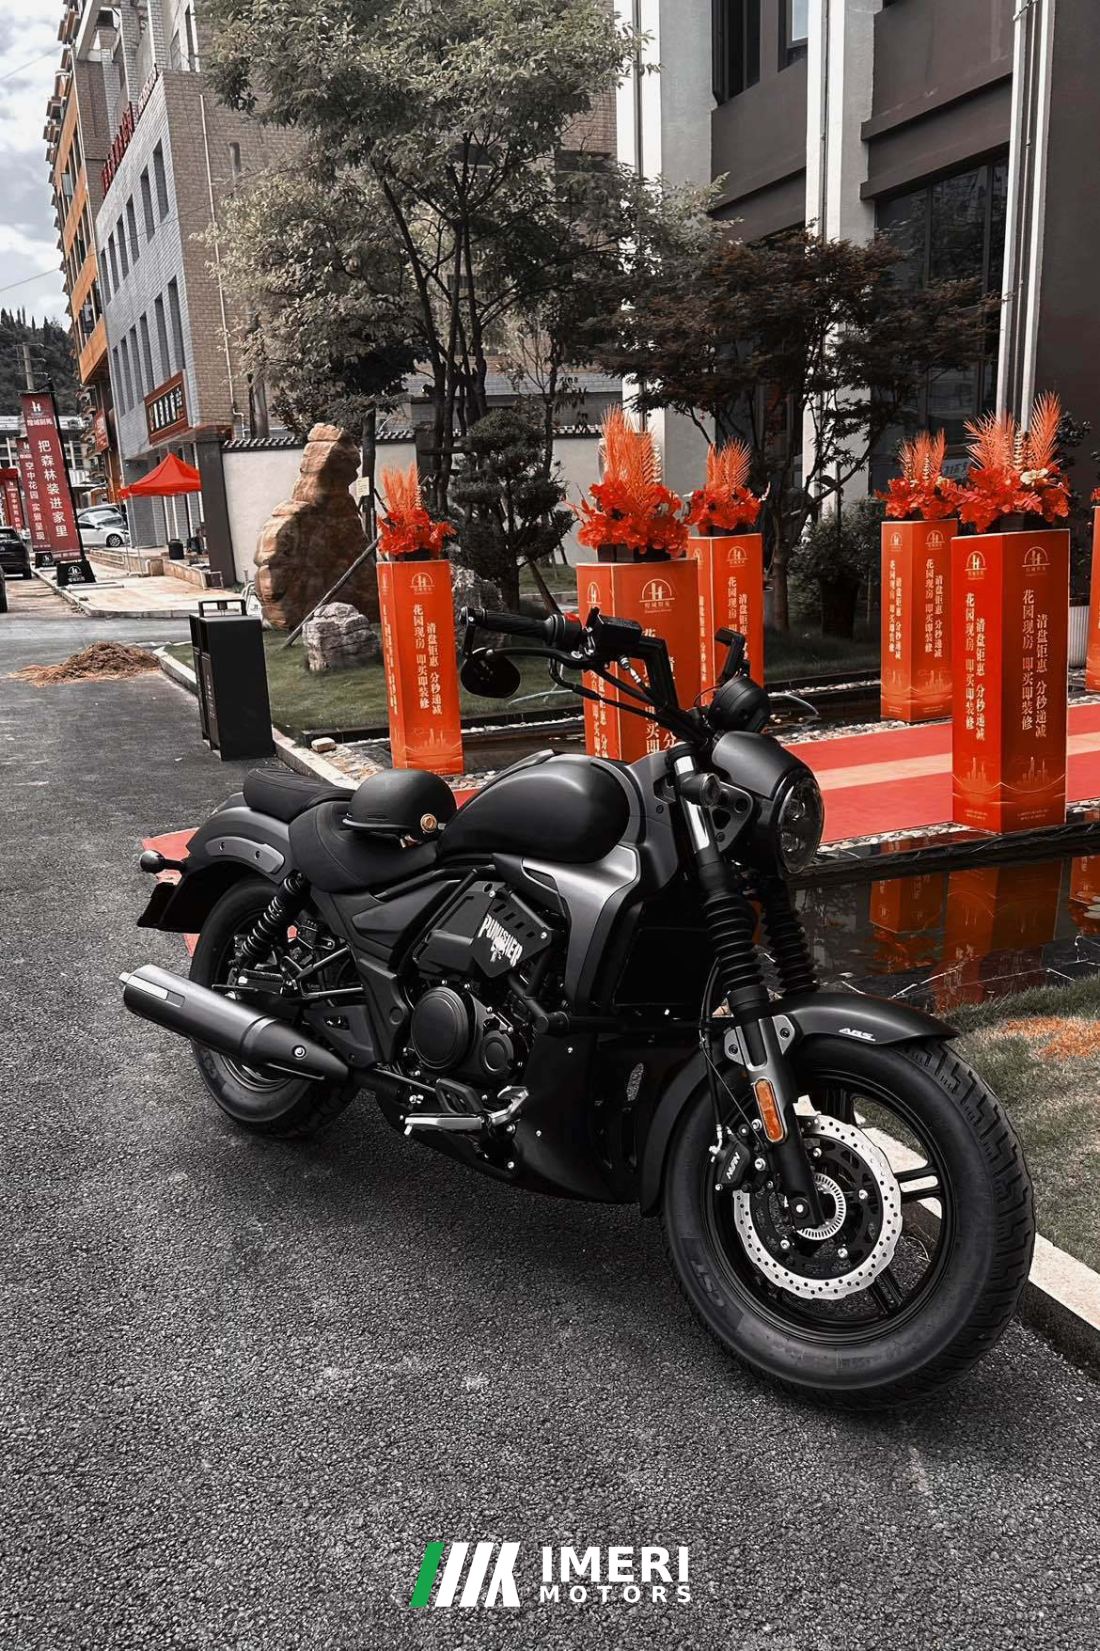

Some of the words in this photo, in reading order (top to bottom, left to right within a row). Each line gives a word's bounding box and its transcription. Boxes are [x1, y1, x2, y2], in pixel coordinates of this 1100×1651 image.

[38, 439, 69, 538] 把森林装进家里
[413, 603, 426, 649] 花园现房
[965, 592, 975, 652] 花园现房
[975, 618, 987, 676] 清盘钜惠
[1022, 589, 1034, 650] 花园现房
[1036, 613, 1049, 674] 清盘钜惠
[416, 654, 430, 710] 即买即装修
[965, 659, 975, 731] 即买即装修
[1021, 657, 1034, 731] 即买即装修
[1035, 680, 1048, 739] 分秒递减
[975, 684, 987, 742] 分秒递减
[478, 913, 523, 967] PUNISHER
[838, 1027, 875, 1041] ABS
